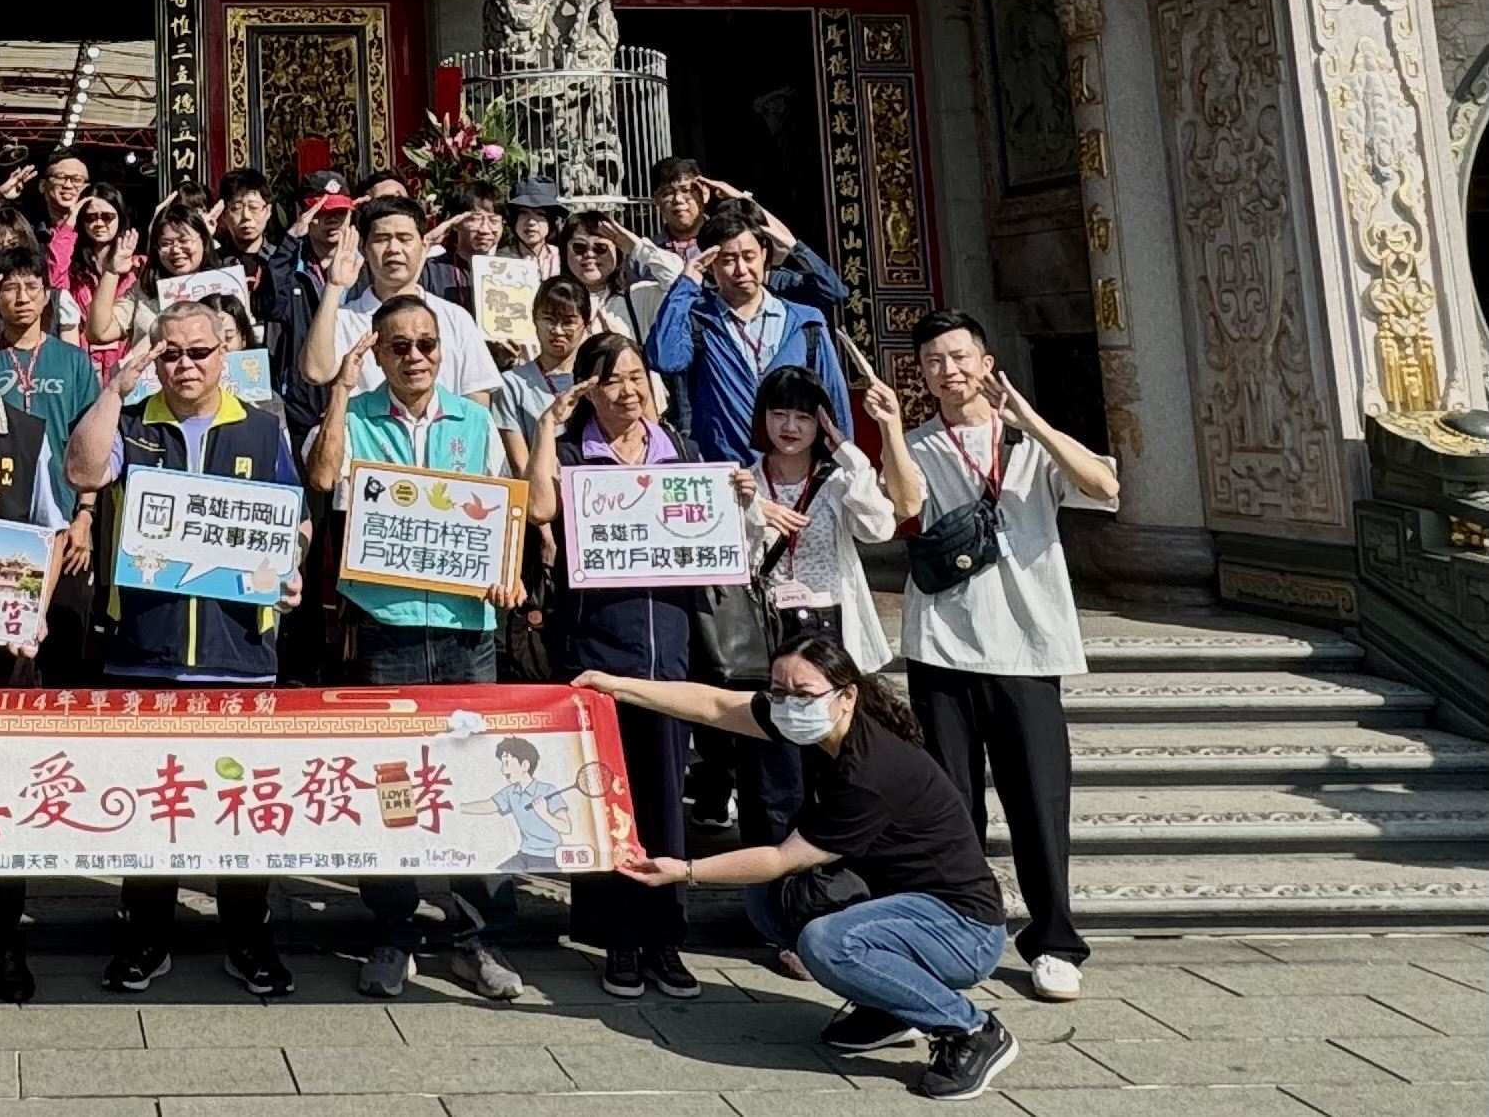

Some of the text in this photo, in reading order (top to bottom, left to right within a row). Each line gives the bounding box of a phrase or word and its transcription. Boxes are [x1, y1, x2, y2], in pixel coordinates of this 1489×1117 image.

[185, 492, 294, 528] 高雄市岡山
[180, 520, 292, 556] 戶政事務所
[362, 510, 492, 553] 高雄市梓官
[590, 523, 649, 543] 高雄市
[359, 540, 491, 582] 戶政事務所
[583, 544, 741, 571] 路竹戶政事務所
[560, 849, 590, 865] 廣告
